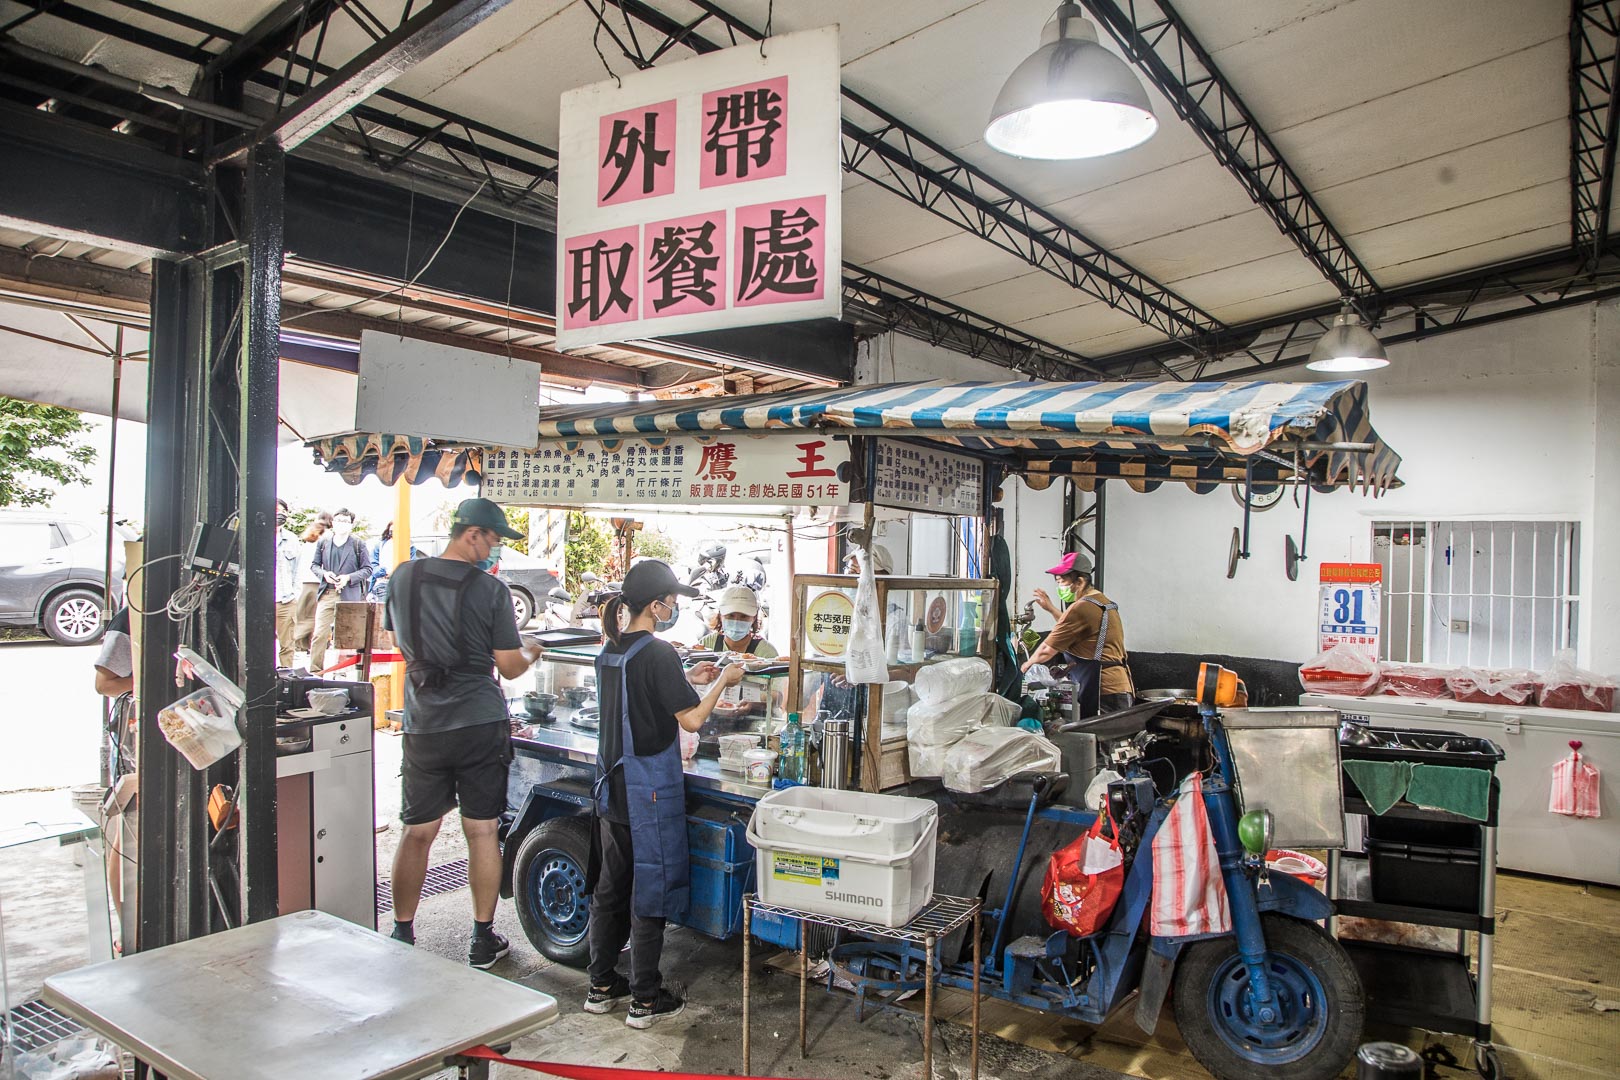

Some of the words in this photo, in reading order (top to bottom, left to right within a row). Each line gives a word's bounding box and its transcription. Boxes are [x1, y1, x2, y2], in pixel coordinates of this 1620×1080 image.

[601, 88, 782, 202] 外帶
[567, 207, 819, 322] 取餐處
[1334, 588, 1366, 624] 31
[825, 890, 883, 908] SHIMANO
